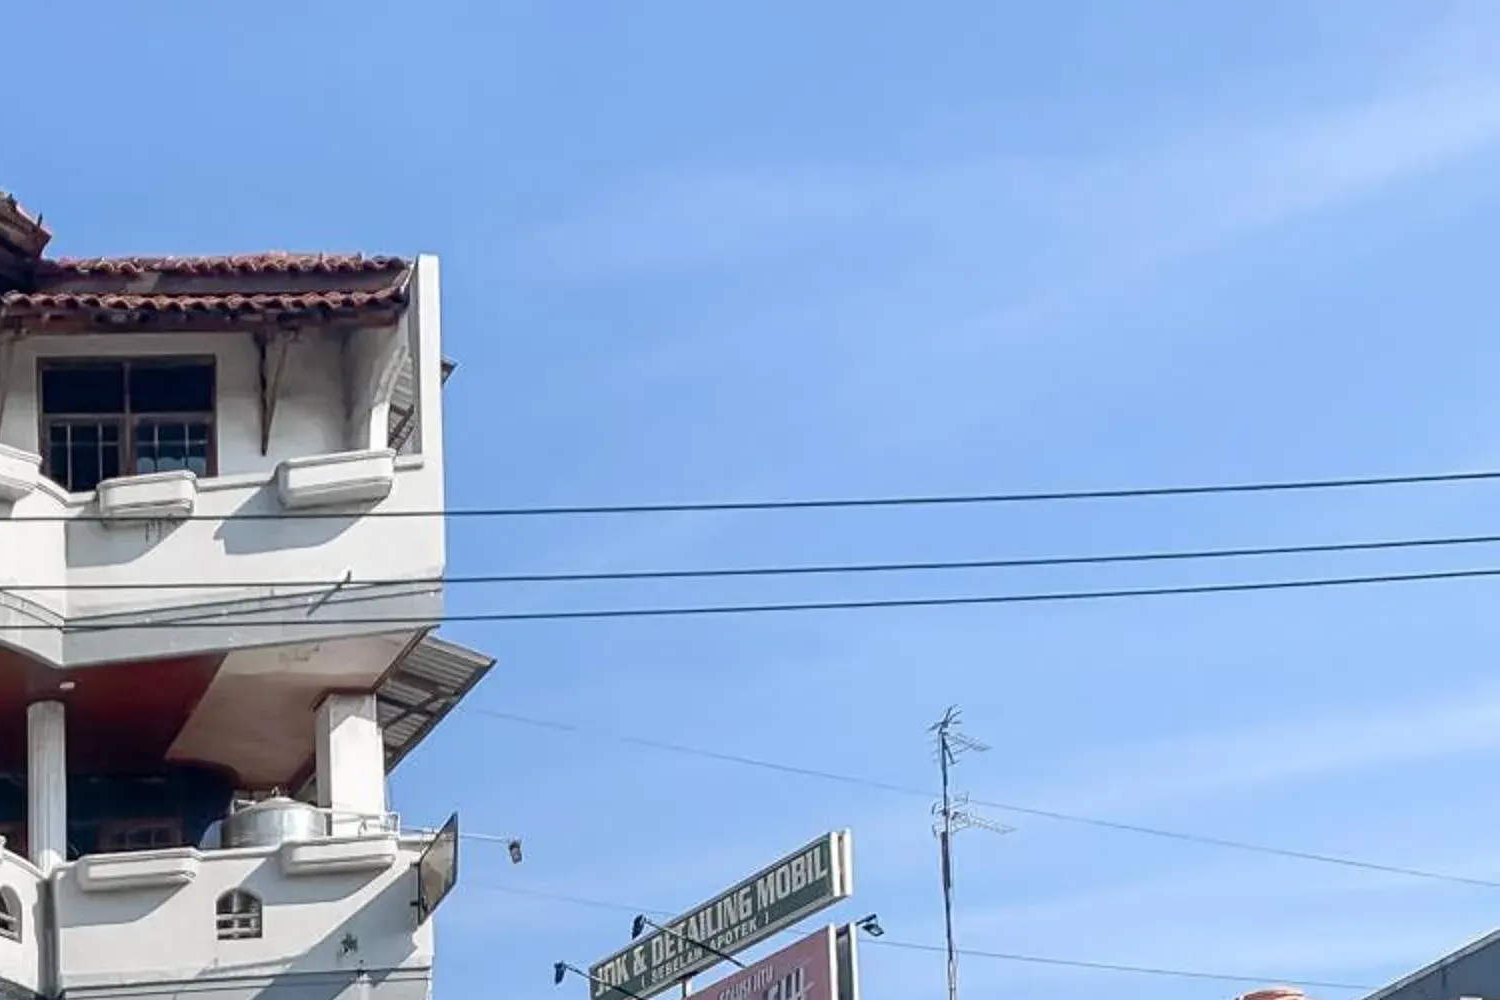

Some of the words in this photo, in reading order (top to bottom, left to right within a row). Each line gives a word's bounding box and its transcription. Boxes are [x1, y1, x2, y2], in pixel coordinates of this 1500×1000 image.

[633, 945, 648, 977] &
[651, 886, 753, 968] DETAILING
[756, 847, 828, 910] MOBIL
[710, 919, 757, 951] APOTEK
